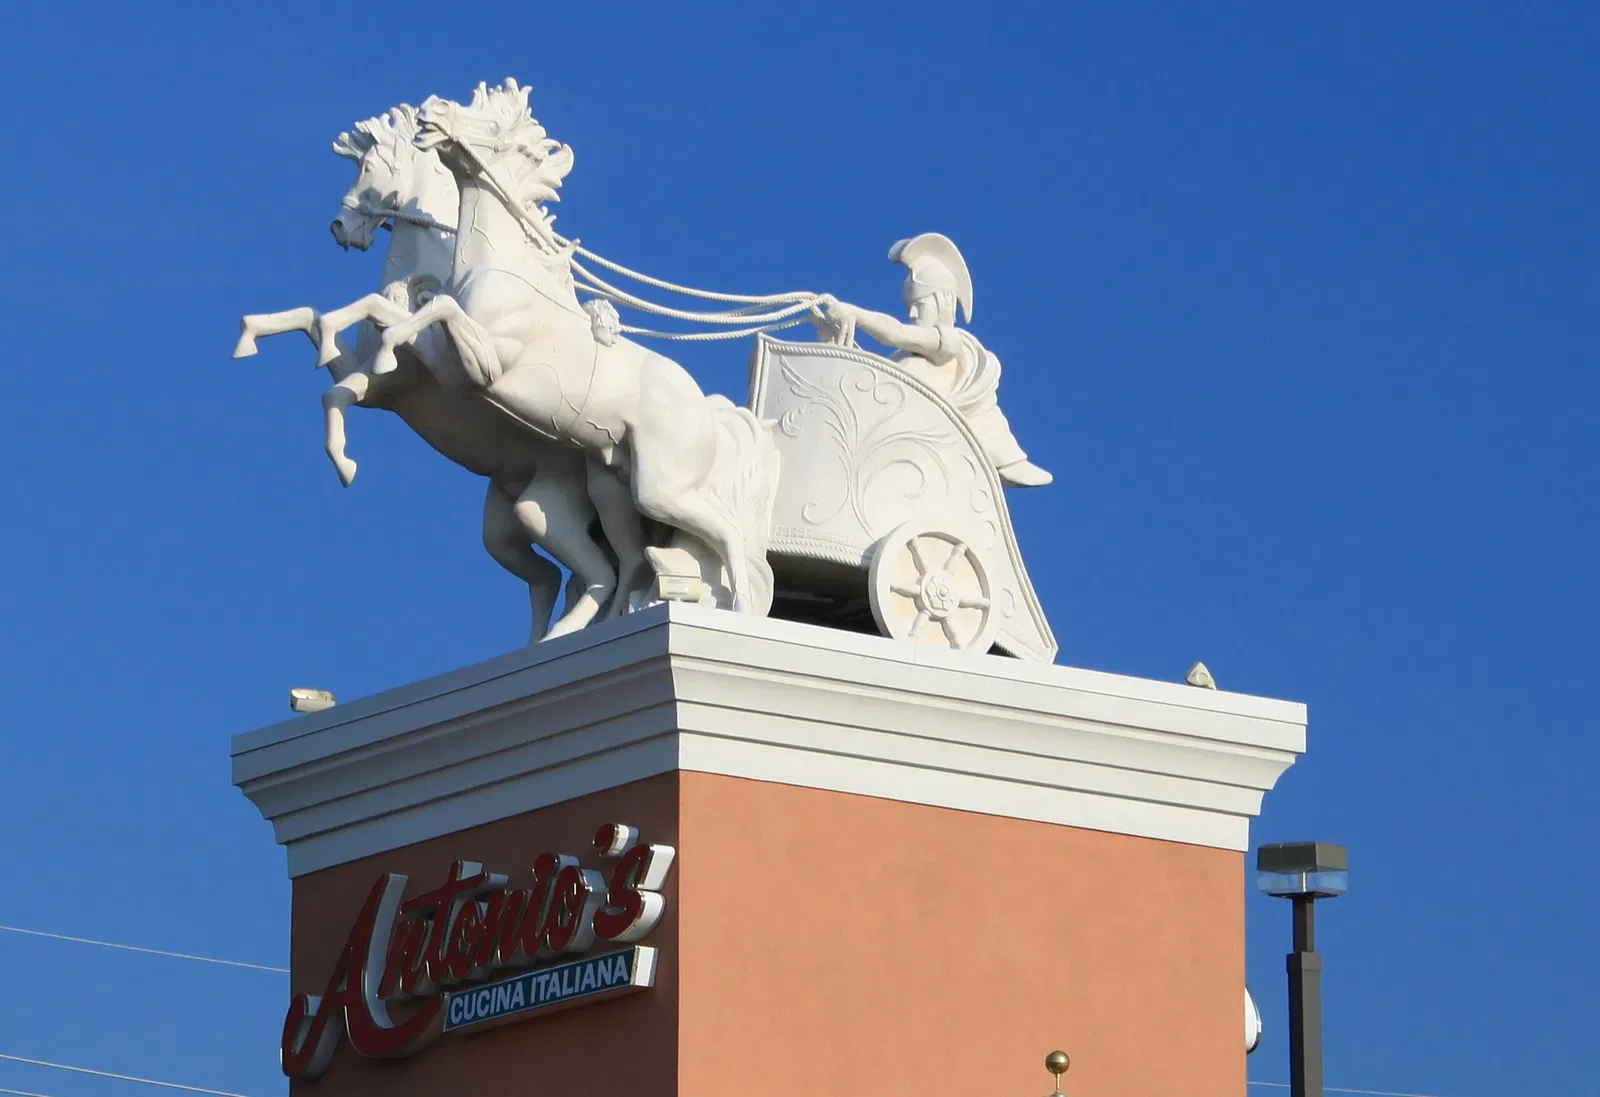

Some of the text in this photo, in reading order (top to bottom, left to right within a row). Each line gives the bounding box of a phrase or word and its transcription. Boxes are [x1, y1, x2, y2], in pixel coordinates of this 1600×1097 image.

[280, 822, 675, 1079] Antonio's
[450, 955, 629, 1025] CUCINA ITALIANA
